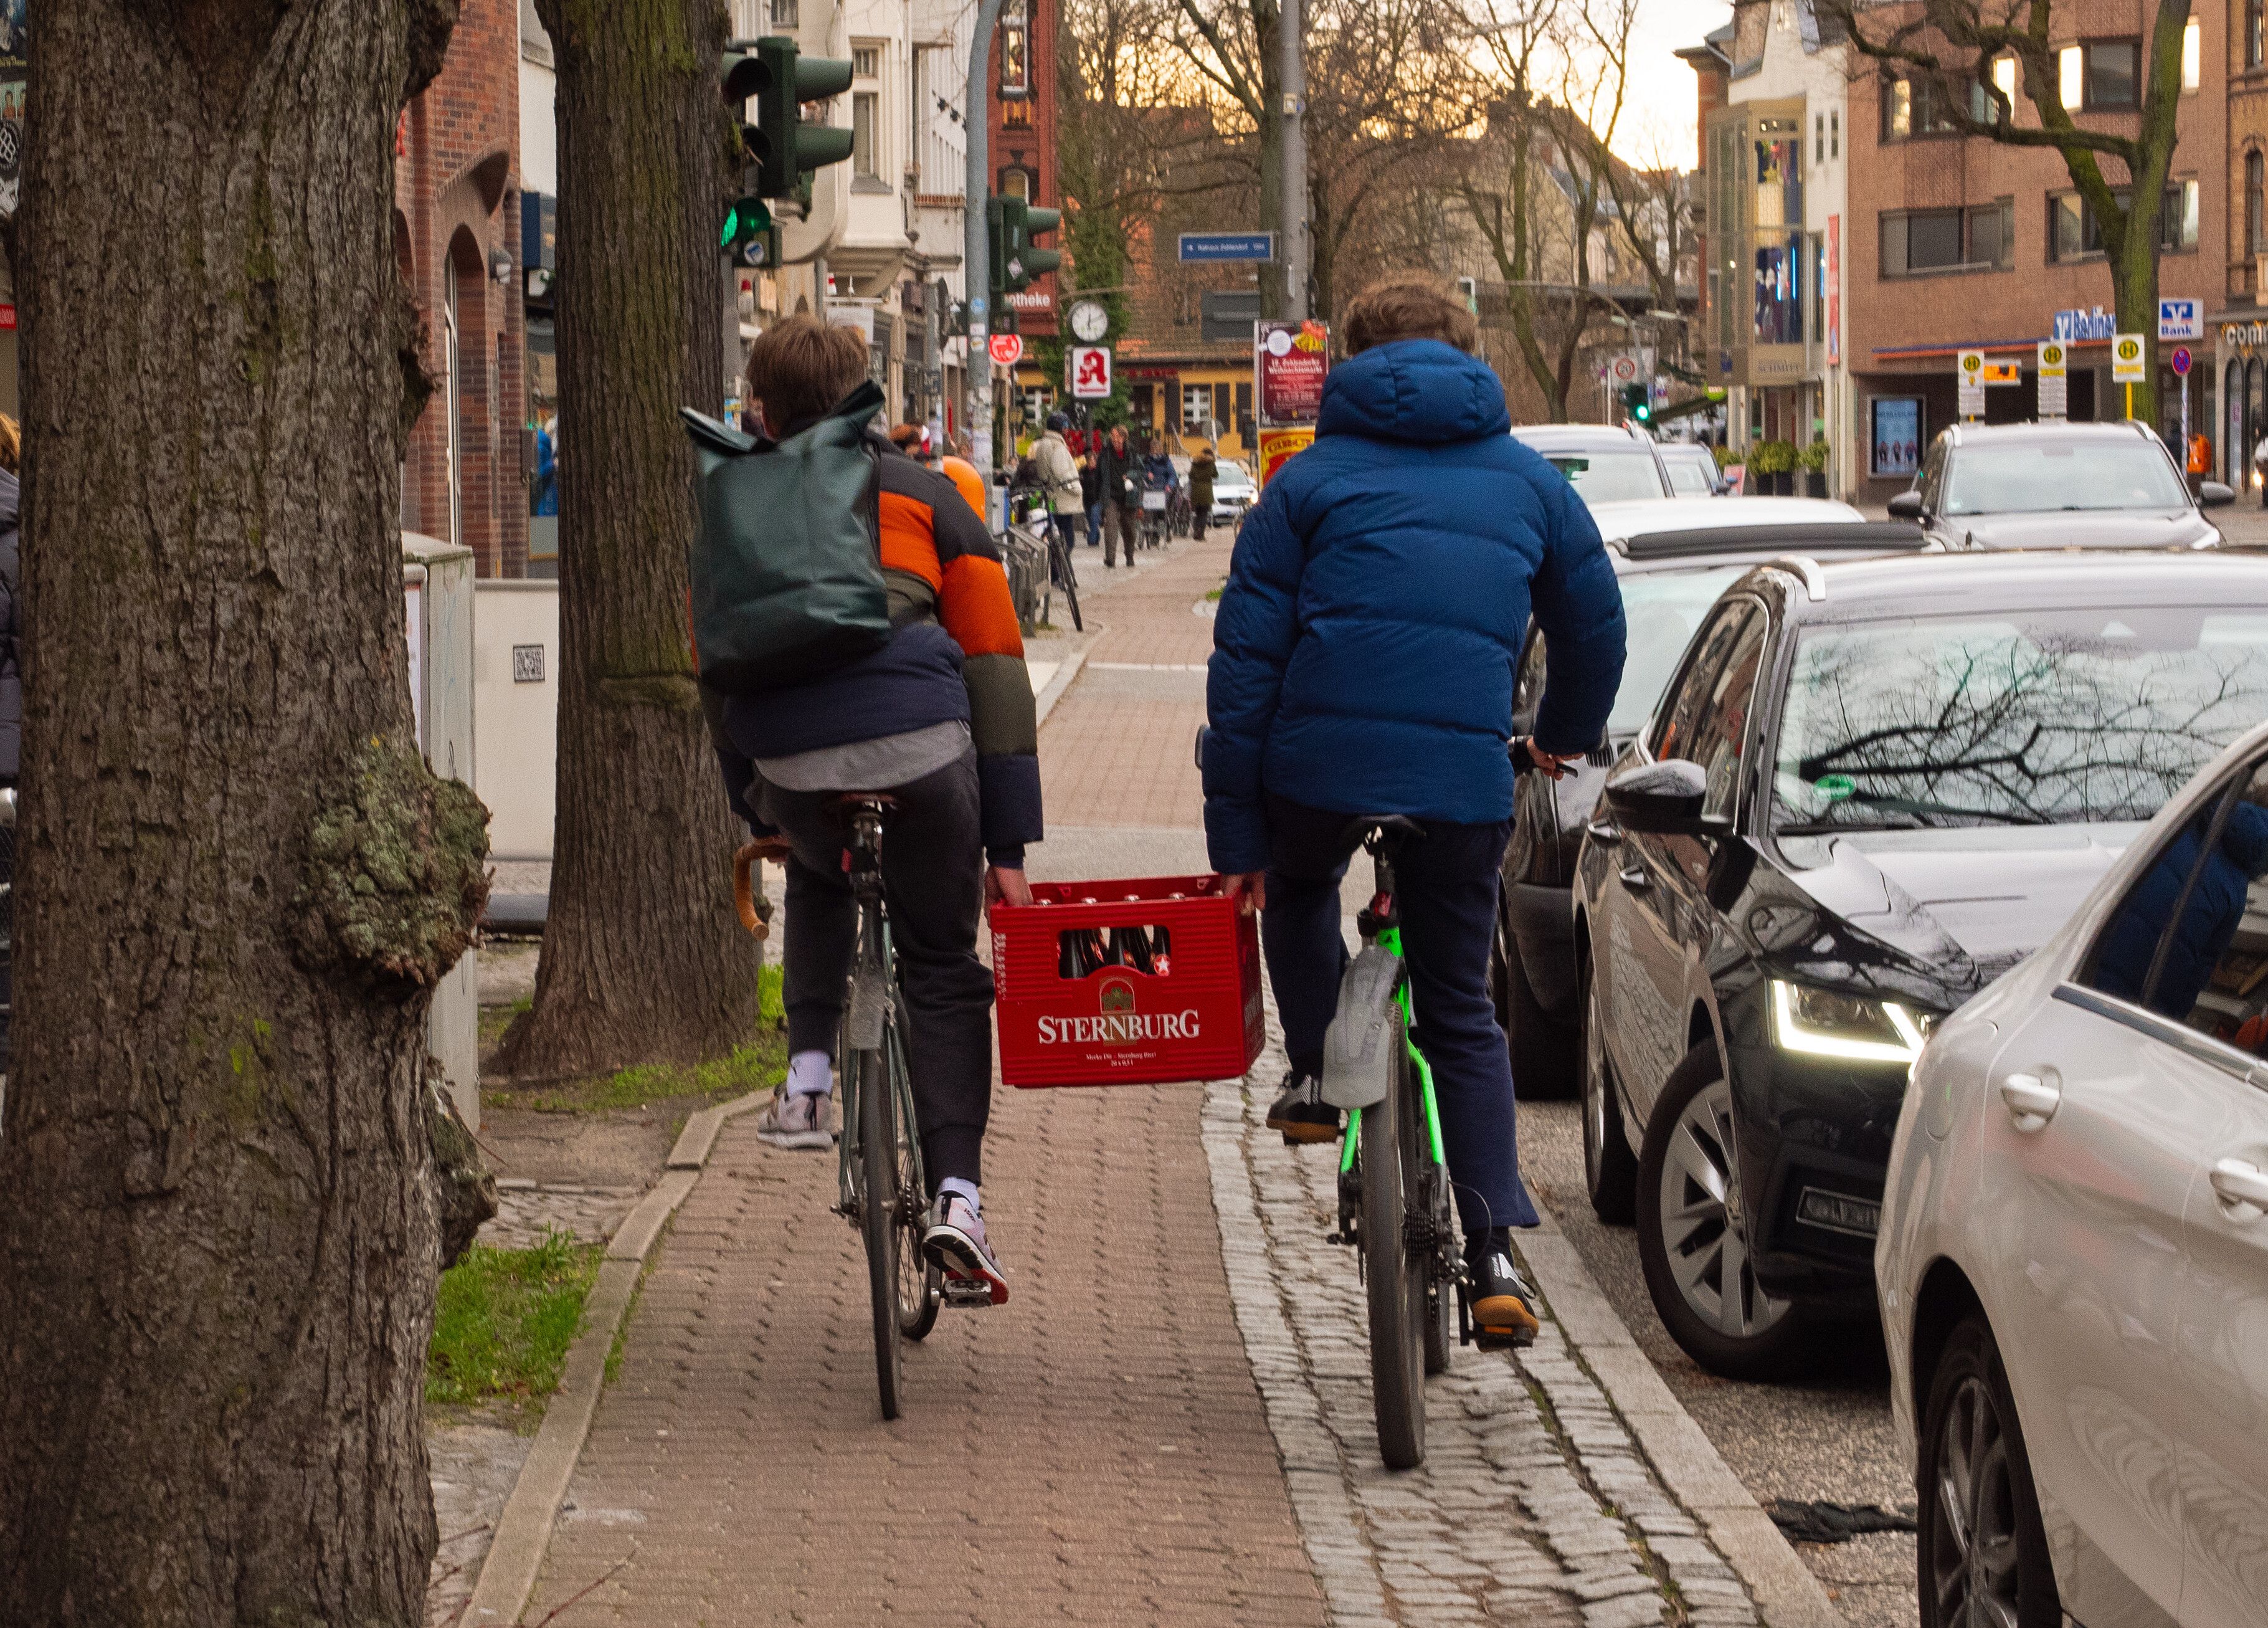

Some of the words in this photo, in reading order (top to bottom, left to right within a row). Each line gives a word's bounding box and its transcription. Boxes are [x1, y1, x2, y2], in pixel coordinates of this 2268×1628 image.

[2161, 325, 2191, 336] Bank
[2226, 324, 2268, 346] com
[1038, 1009, 1200, 1045] STERNBURG
